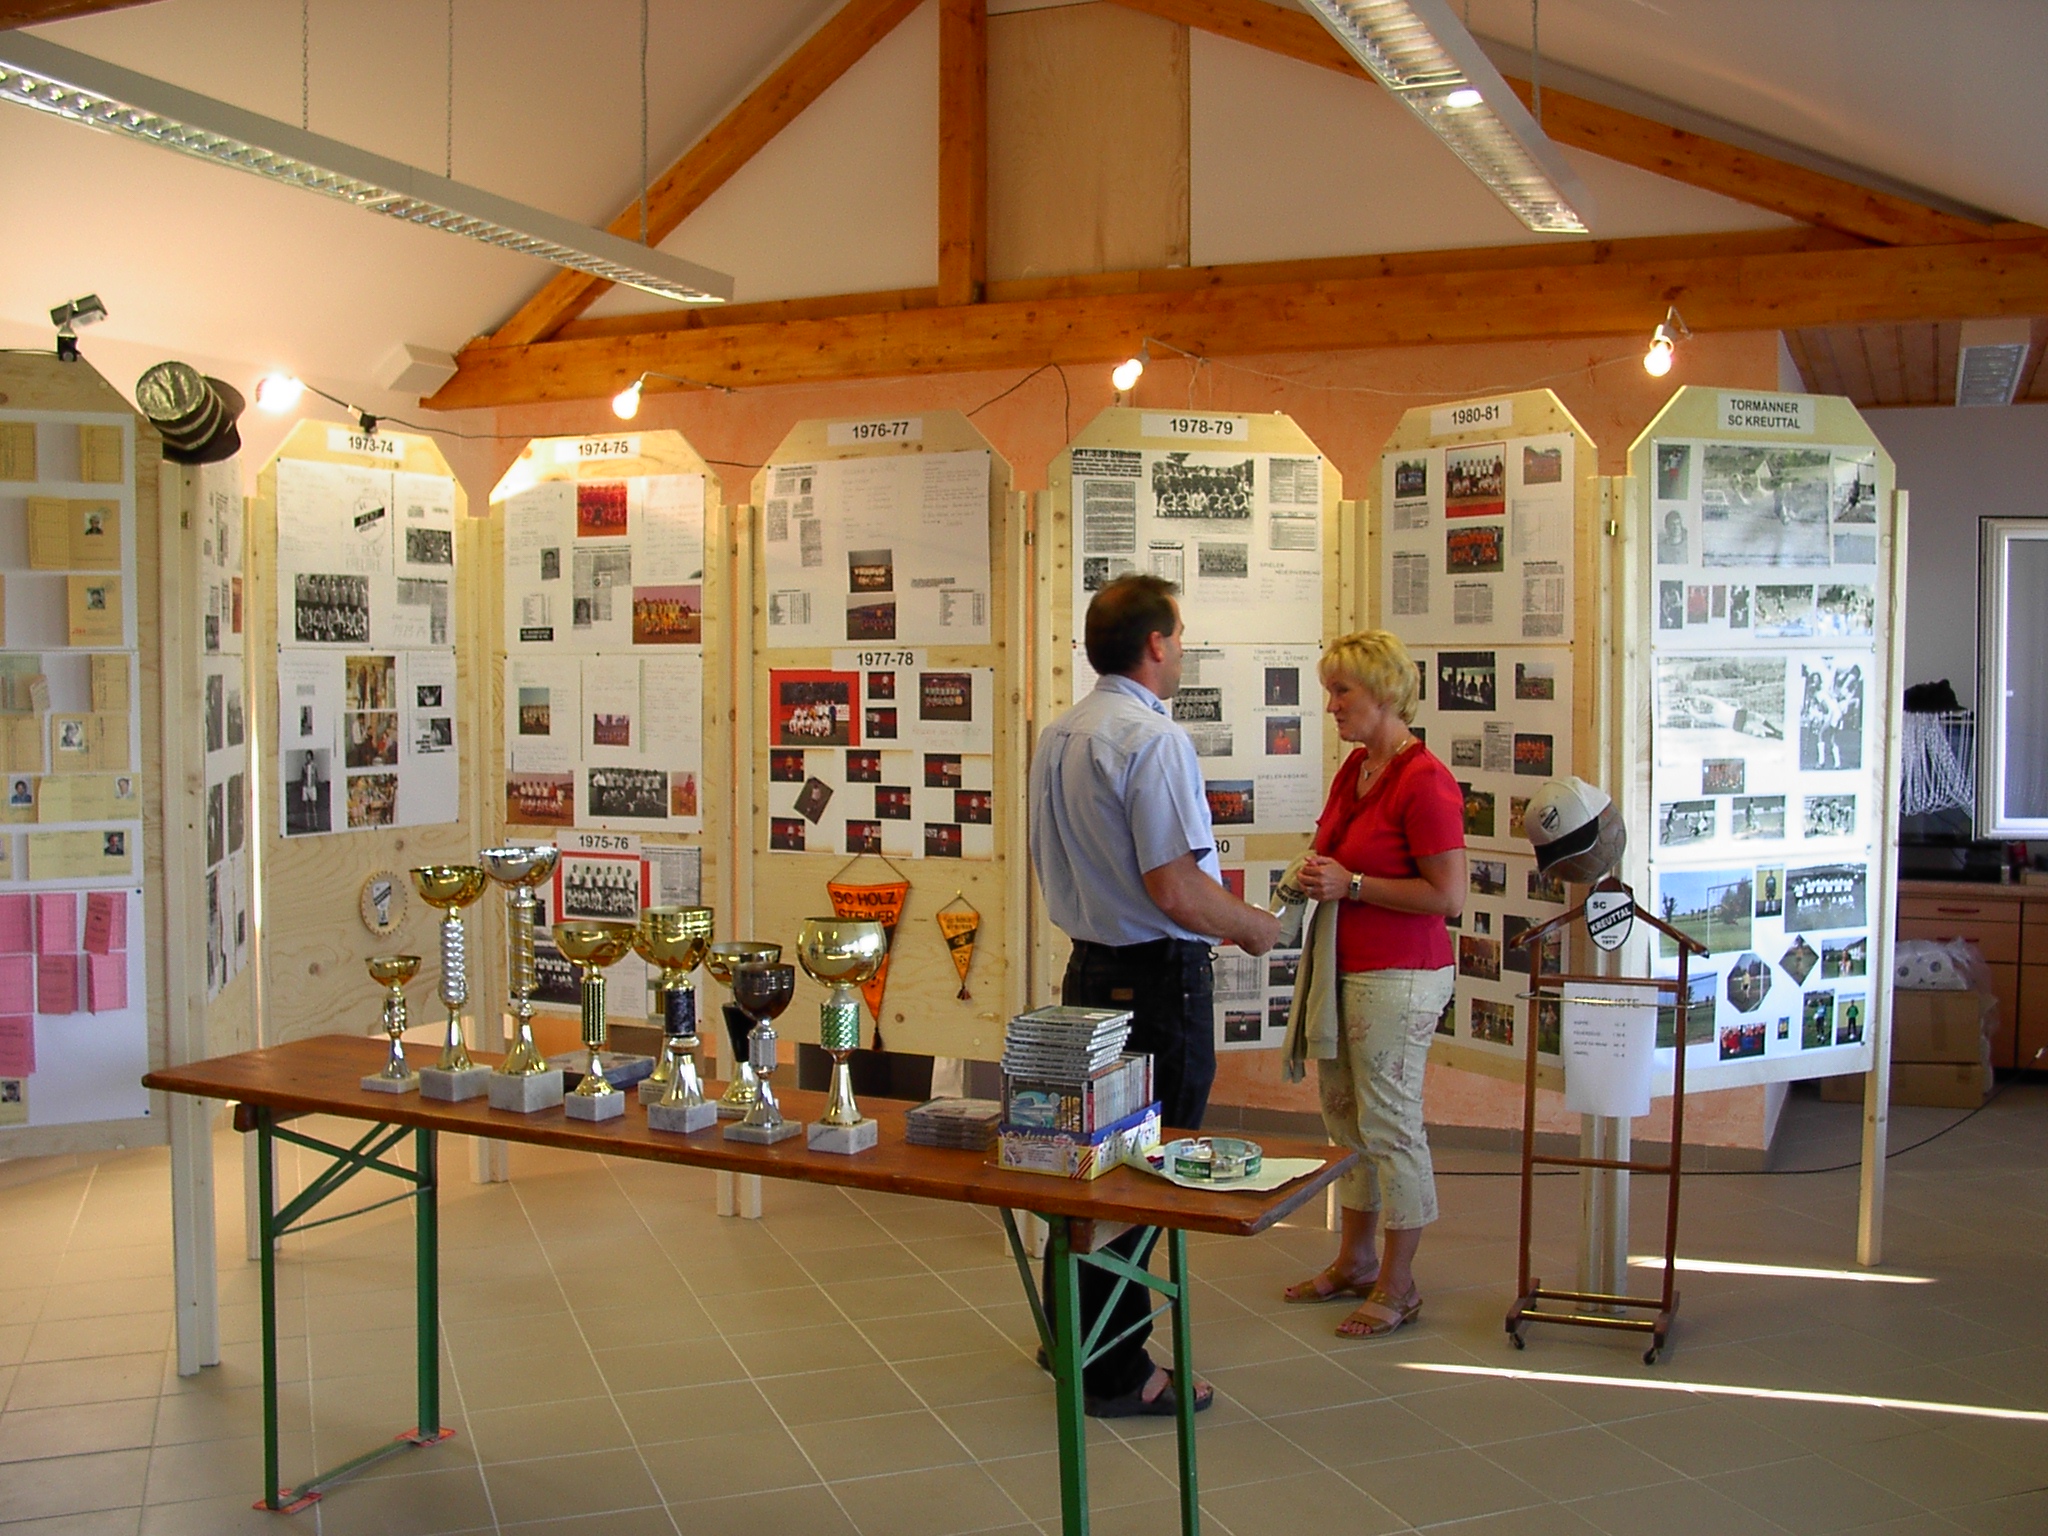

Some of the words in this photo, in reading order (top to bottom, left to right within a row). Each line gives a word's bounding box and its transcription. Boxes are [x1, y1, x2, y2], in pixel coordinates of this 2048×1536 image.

[1730, 398, 1799, 414] TORMÄNNER
[1452, 405, 1500, 426] 1980-81
[1728, 414, 1743, 427] SC
[1745, 415, 1801, 429] KREUTTAL
[852, 421, 909, 439] 1976-77
[1169, 418, 1233, 435] 1978-79
[348, 435, 394, 454] 1973-74
[578, 441, 629, 456] 1974-75
[857, 651, 914, 667] 1977-78
[578, 835, 629, 850] 1975-76
[833, 890, 854, 905] SC
[857, 891, 898, 906] HOLZ
[1592, 901, 1607, 909] SC
[1590, 907, 1632, 934] KREUTTAL
